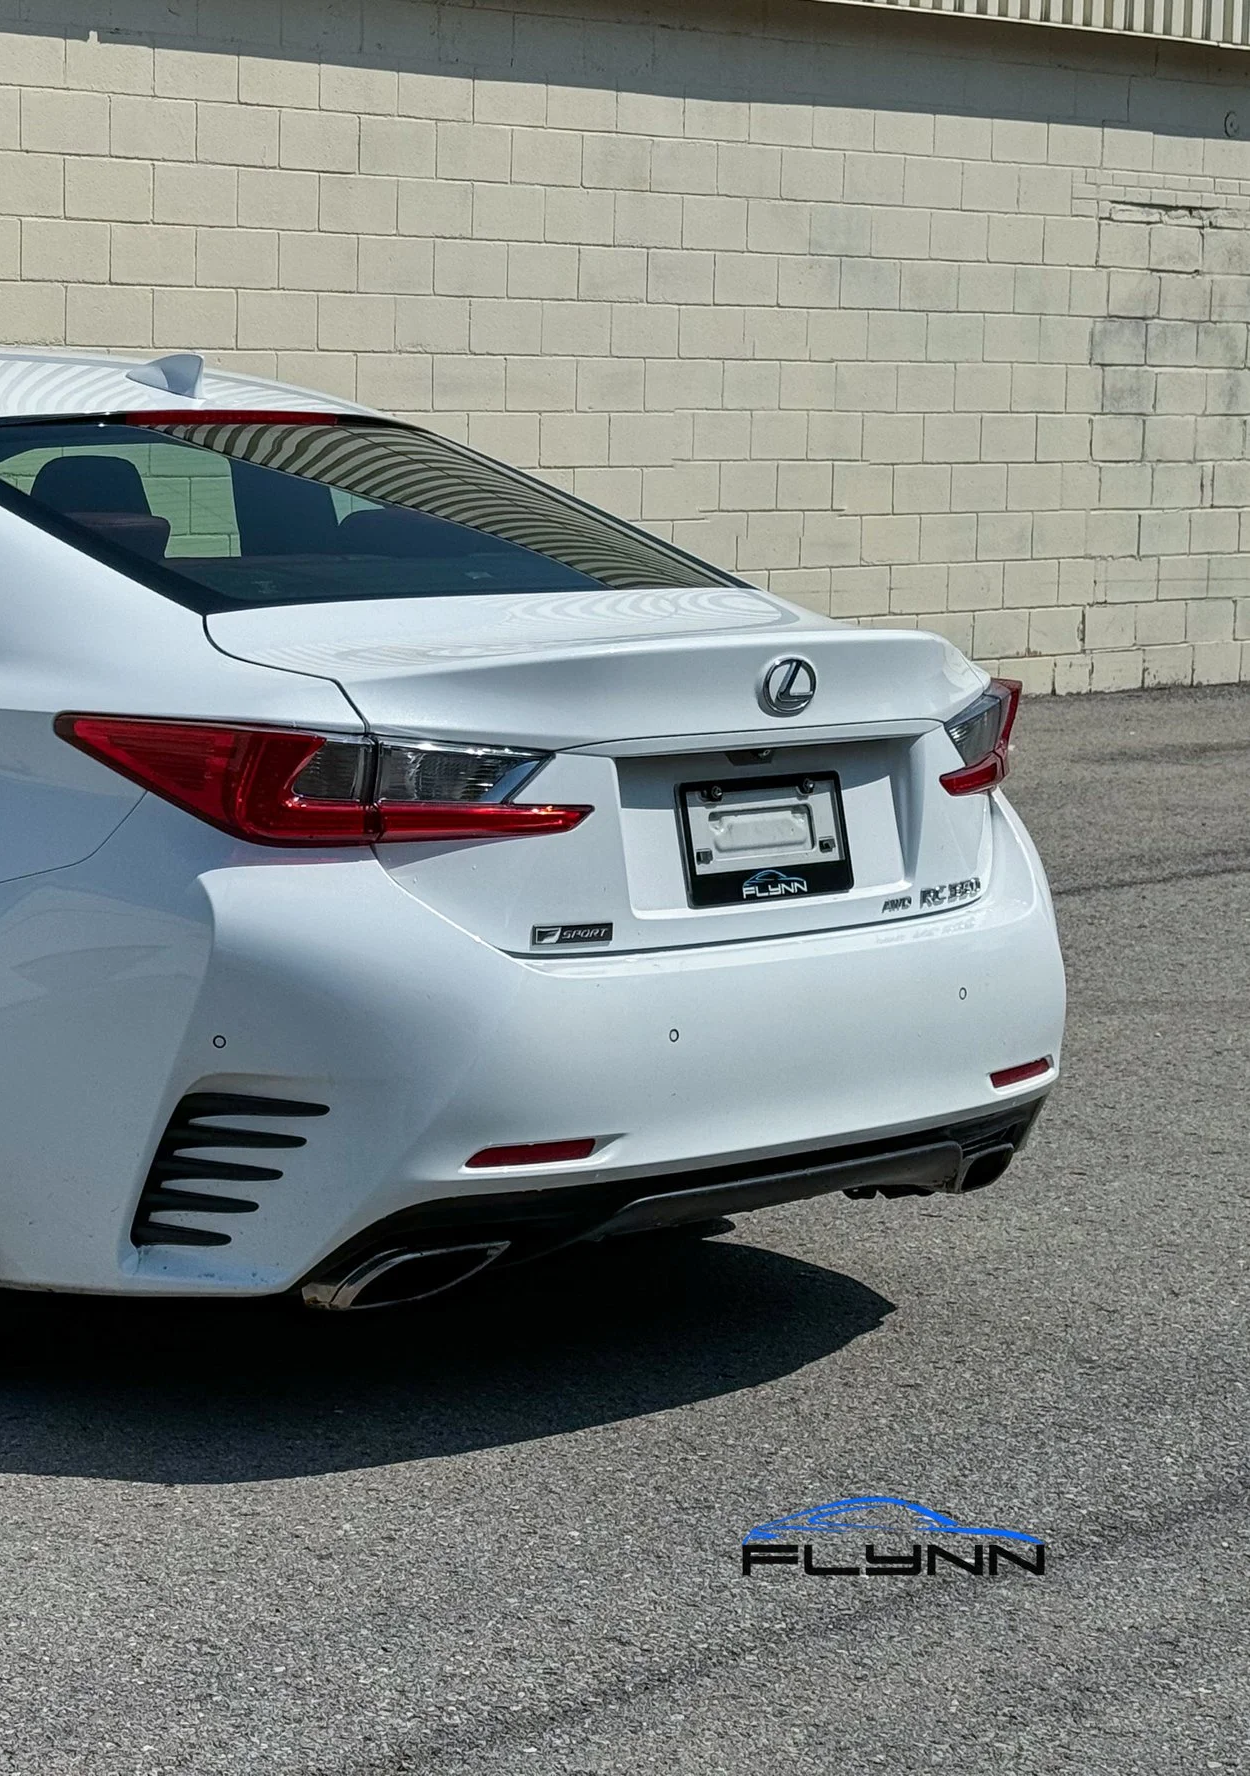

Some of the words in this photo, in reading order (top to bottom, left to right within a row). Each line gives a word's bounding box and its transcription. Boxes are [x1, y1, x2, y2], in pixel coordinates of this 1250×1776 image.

[742, 881, 808, 899] FLYNN
[881, 896, 912, 913] AWD
[561, 928, 609, 939] SPORT
